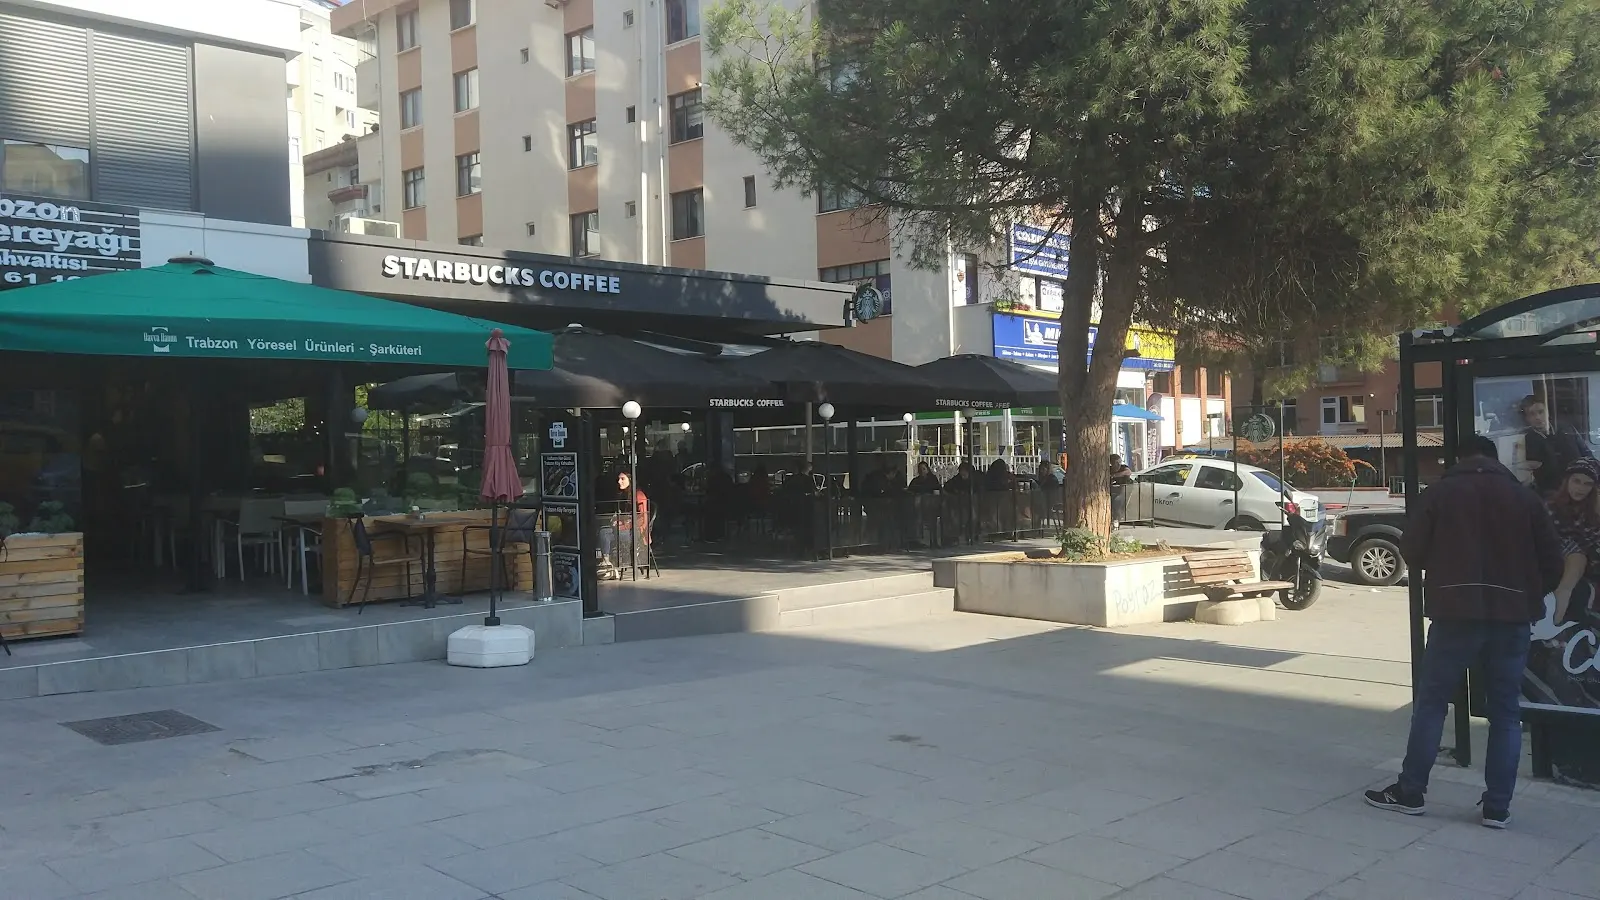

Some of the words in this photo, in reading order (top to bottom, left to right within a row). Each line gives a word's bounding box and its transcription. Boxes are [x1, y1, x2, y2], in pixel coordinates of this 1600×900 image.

[0, 249, 88, 271] hvaltısı
[4, 271, 37, 284] 61
[383, 254, 535, 287] STARBUCKS
[539, 270, 621, 294] COFFEE
[185, 336, 238, 349] Trabzon
[247, 338, 297, 351] Yöresel
[304, 338, 355, 353] Ürünleri
[369, 343, 422, 356] Şarküteri
[709, 398, 754, 407] STARBUCKS
[756, 398, 784, 407] COFFEE
[935, 399, 970, 407] STARBUCKS
[971, 401, 994, 409] COFFEE
[1154, 497, 1174, 506] nkron
